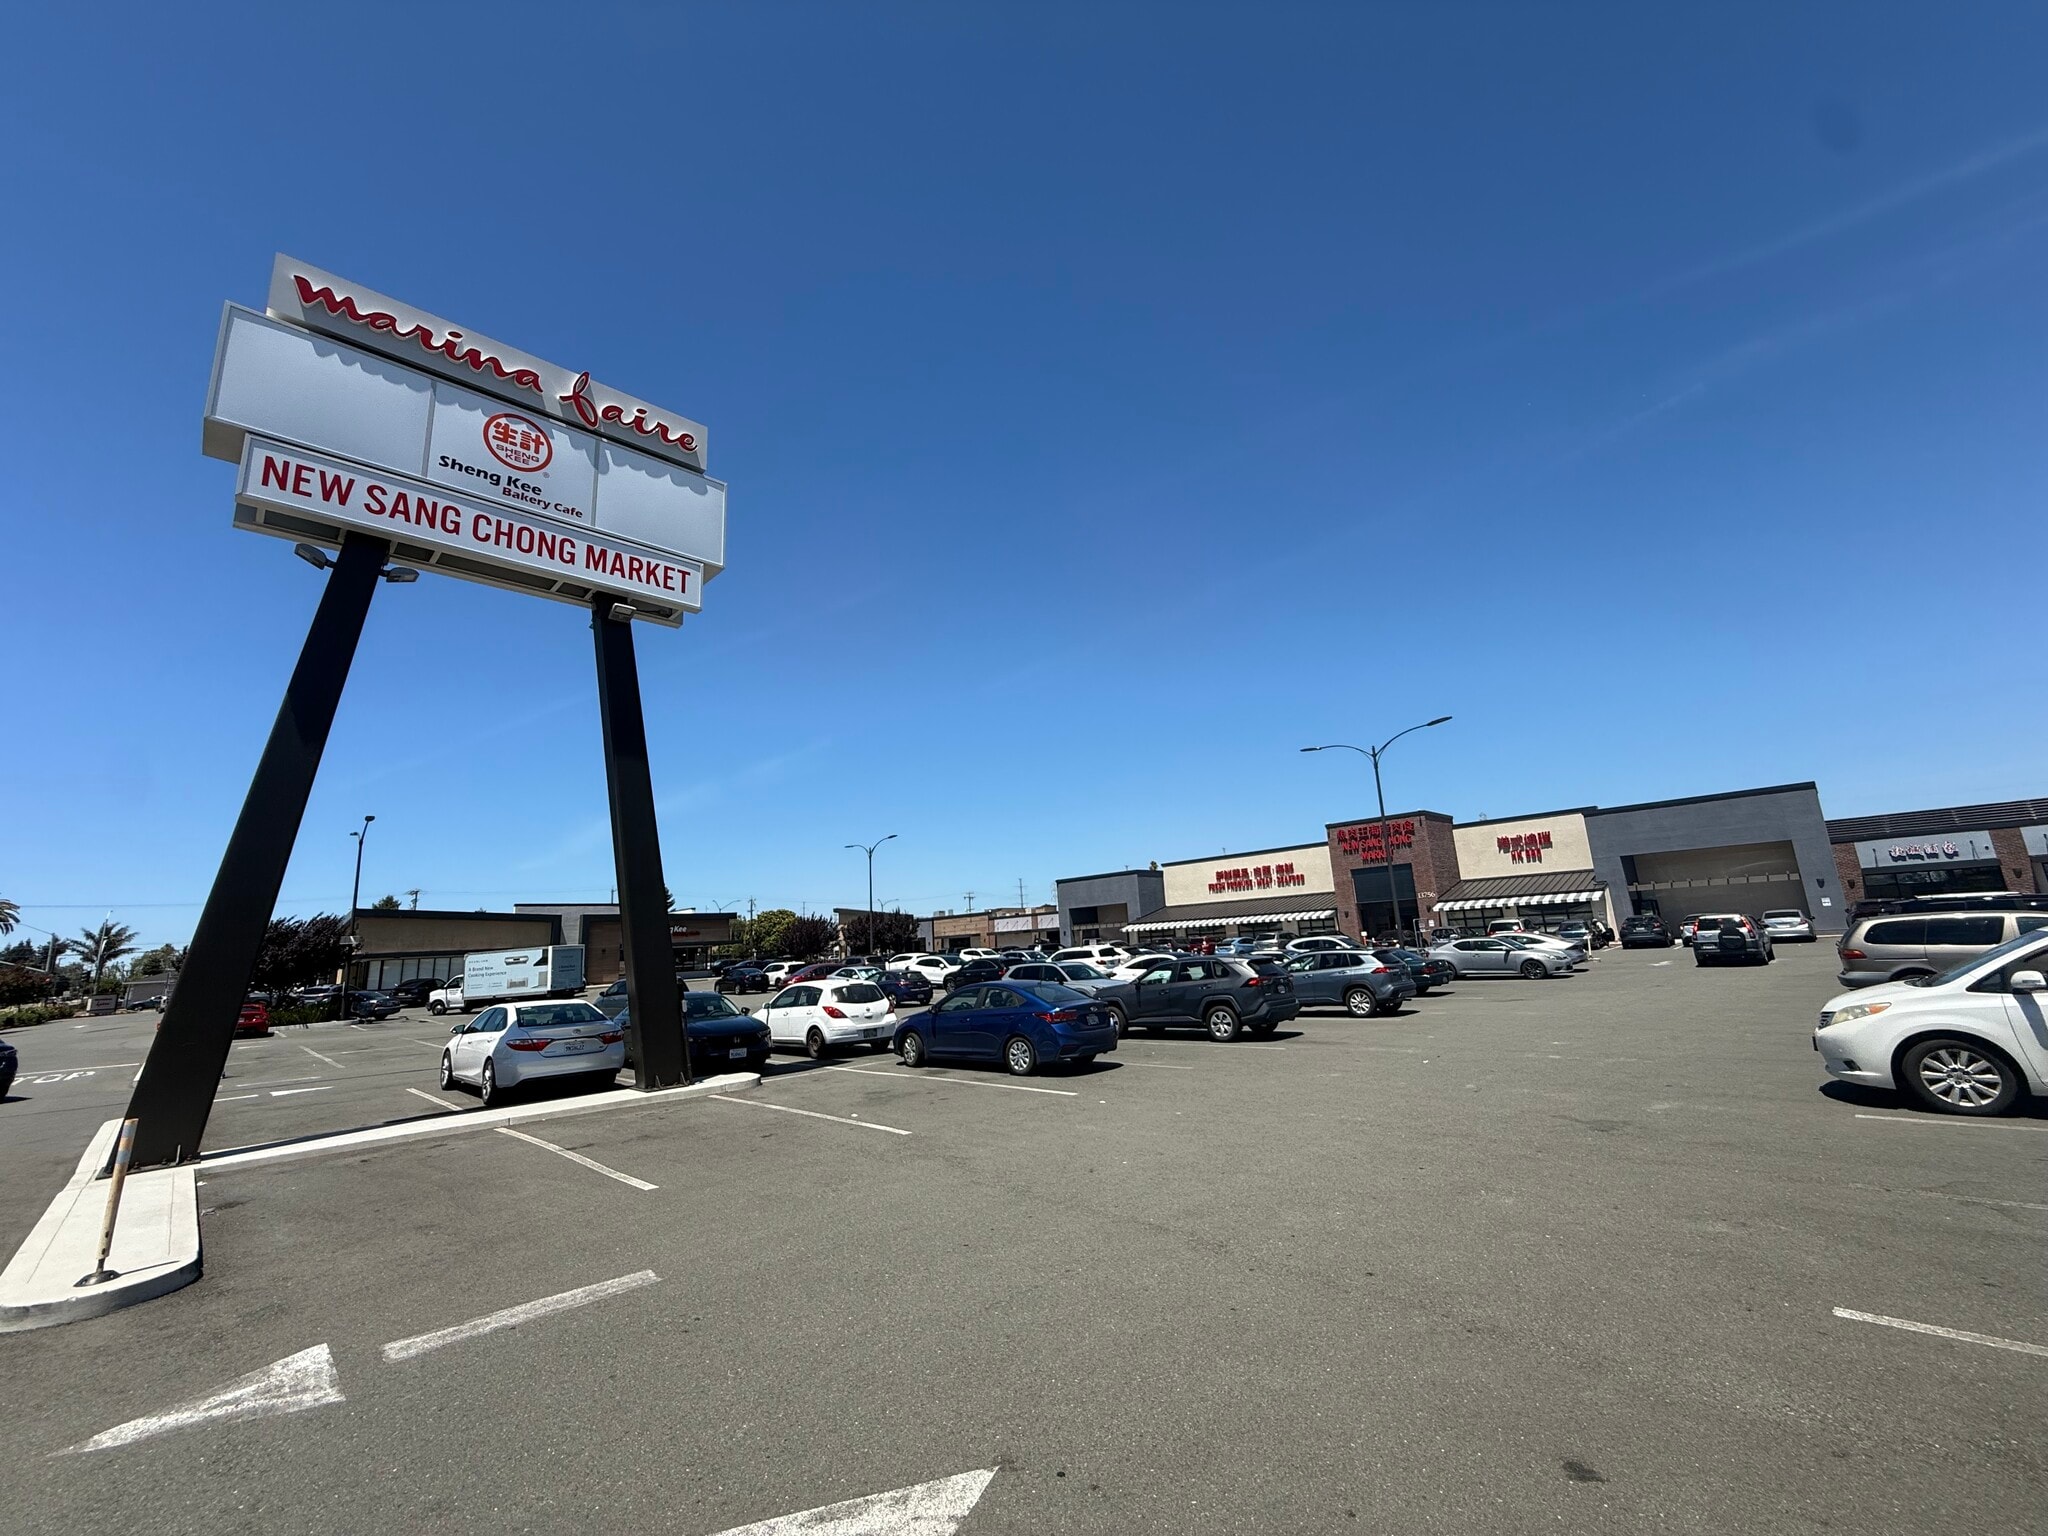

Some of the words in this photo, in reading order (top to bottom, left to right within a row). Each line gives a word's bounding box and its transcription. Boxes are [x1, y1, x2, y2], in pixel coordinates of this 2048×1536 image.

[293, 275, 543, 394] marina
[559, 371, 698, 453] faire
[492, 421, 544, 455] 生計
[496, 444, 540, 463] SHENG
[438, 455, 501, 486] Sheng
[506, 475, 542, 495] Kee
[505, 453, 530, 465] KEE
[502, 486, 551, 510] Bakery
[554, 502, 583, 518] Cafe
[261, 455, 355, 507] NEW
[363, 484, 461, 536] SANG
[472, 514, 576, 566] CHONG
[585, 544, 691, 594] MARKET
